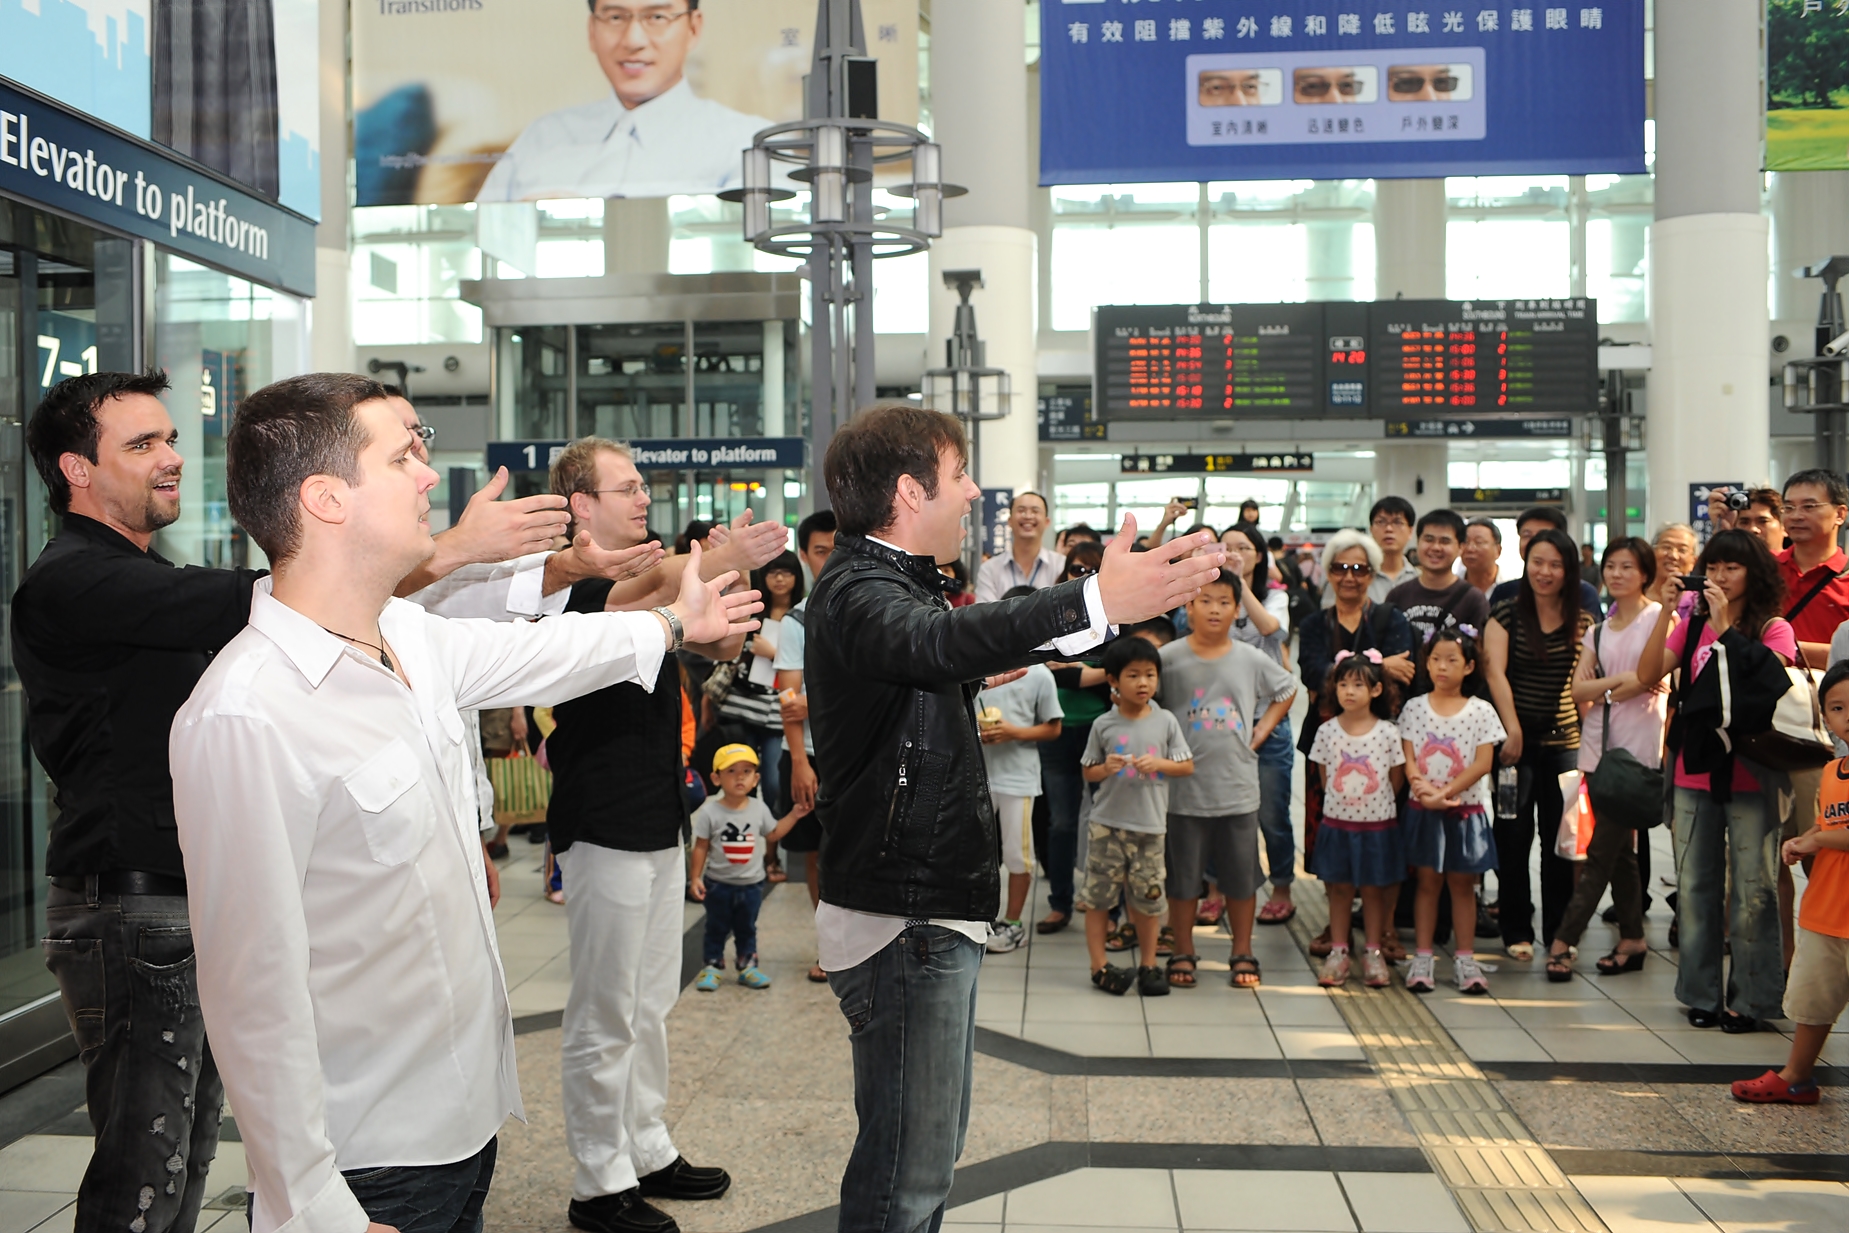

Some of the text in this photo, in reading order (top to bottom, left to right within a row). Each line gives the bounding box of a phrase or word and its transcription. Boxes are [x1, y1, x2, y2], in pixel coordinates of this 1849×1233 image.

[377, 0, 483, 15] Transitions
[0, 109, 268, 260] Elevator to platform
[523, 445, 537, 469] 1
[691, 448, 708, 463] to
[711, 445, 777, 466] platform
